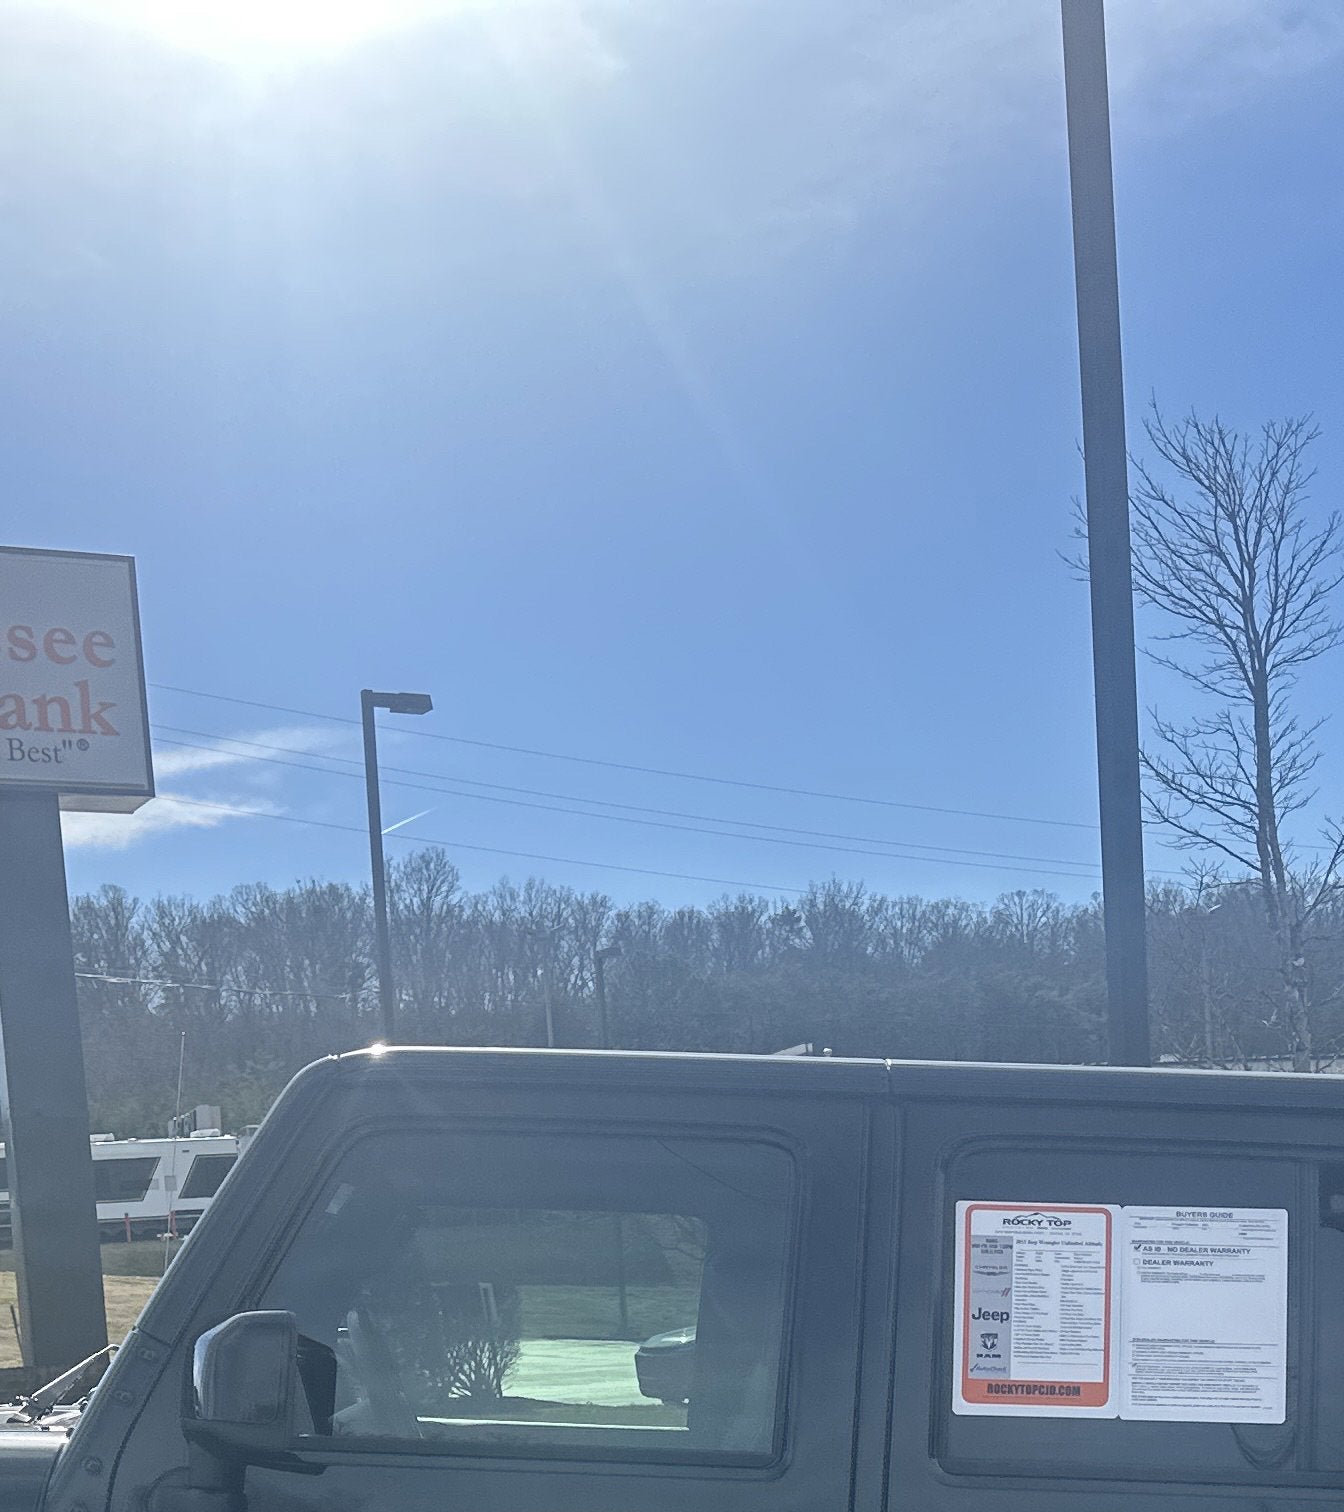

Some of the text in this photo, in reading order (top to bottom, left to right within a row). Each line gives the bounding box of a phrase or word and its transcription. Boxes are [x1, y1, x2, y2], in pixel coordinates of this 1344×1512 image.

[1002, 1218, 1072, 1227] ROCKY TOP
[972, 1307, 1010, 1324] Jeep
